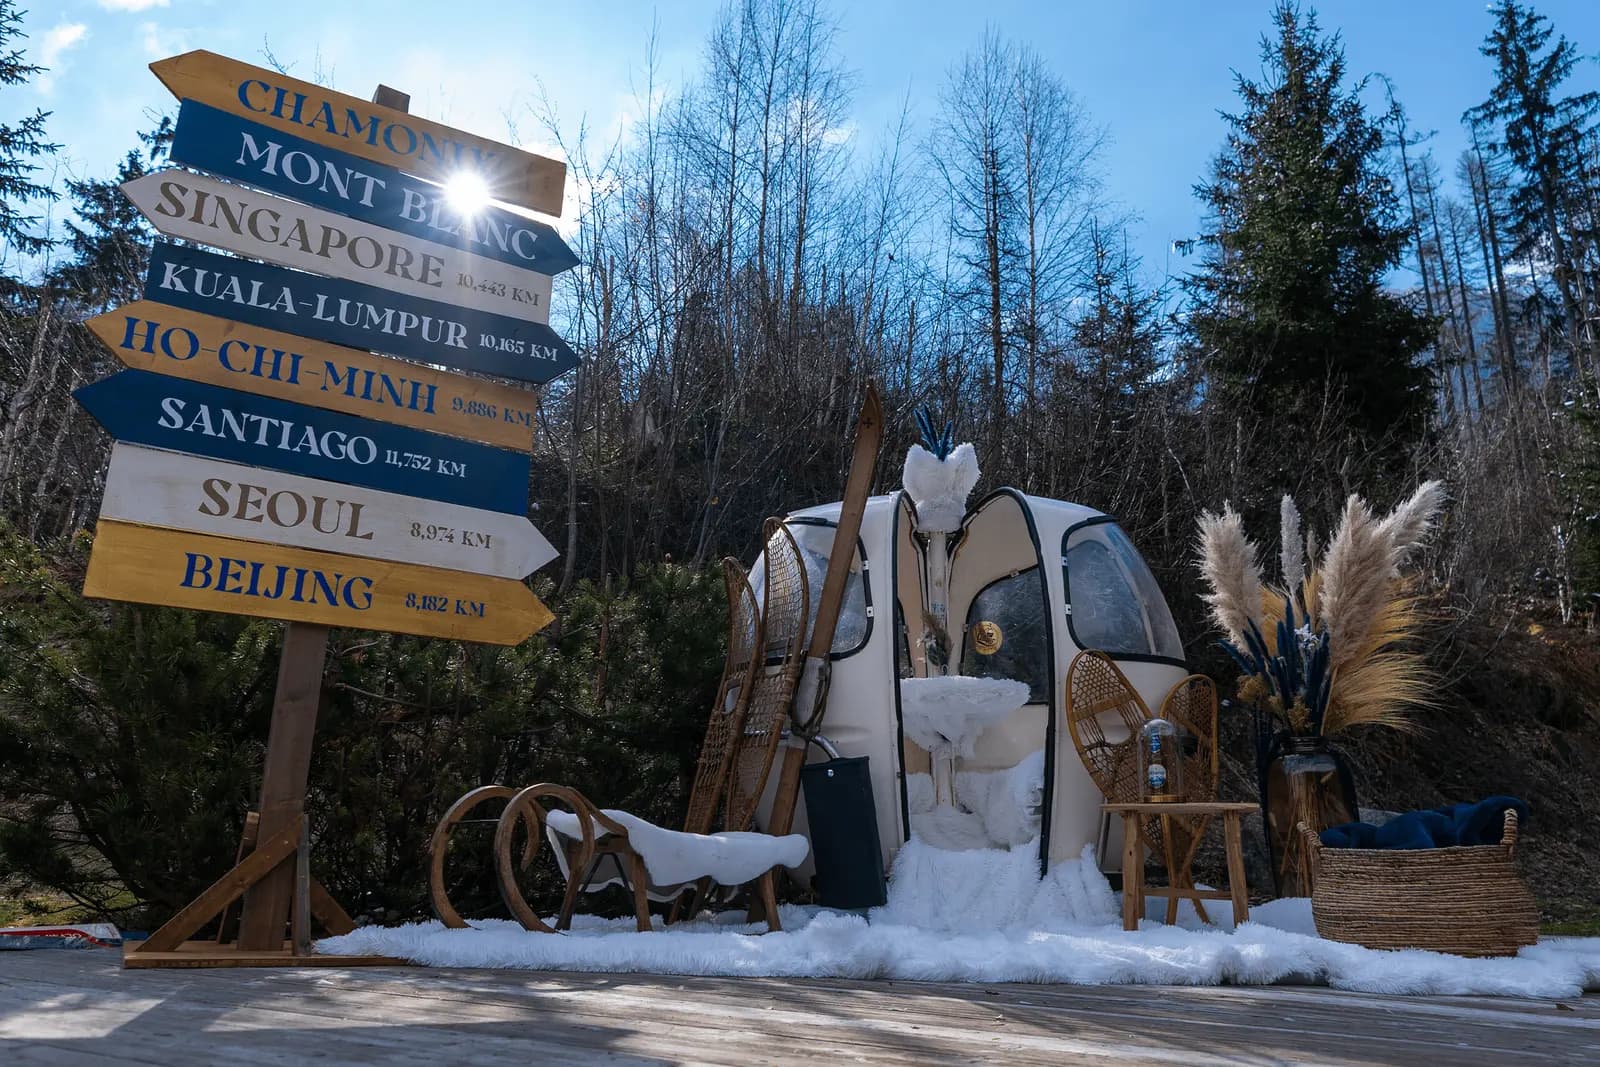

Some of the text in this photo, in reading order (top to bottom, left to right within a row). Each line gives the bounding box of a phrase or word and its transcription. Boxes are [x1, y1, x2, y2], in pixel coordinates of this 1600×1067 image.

[154, 181, 541, 307] SINGAPORE 10,443 KM
[235, 131, 538, 260] MONT BLANC
[159, 262, 558, 362] KUALA-LUMPUR 10,165 KM
[120, 316, 533, 427] HO-CHI-MINH 9,886 KM
[157, 397, 466, 478] SANTIAGO 11,752 KM
[198, 478, 492, 549] SEOUL 8,974 KM
[180, 551, 486, 618] BEIJING 8,182 KM
